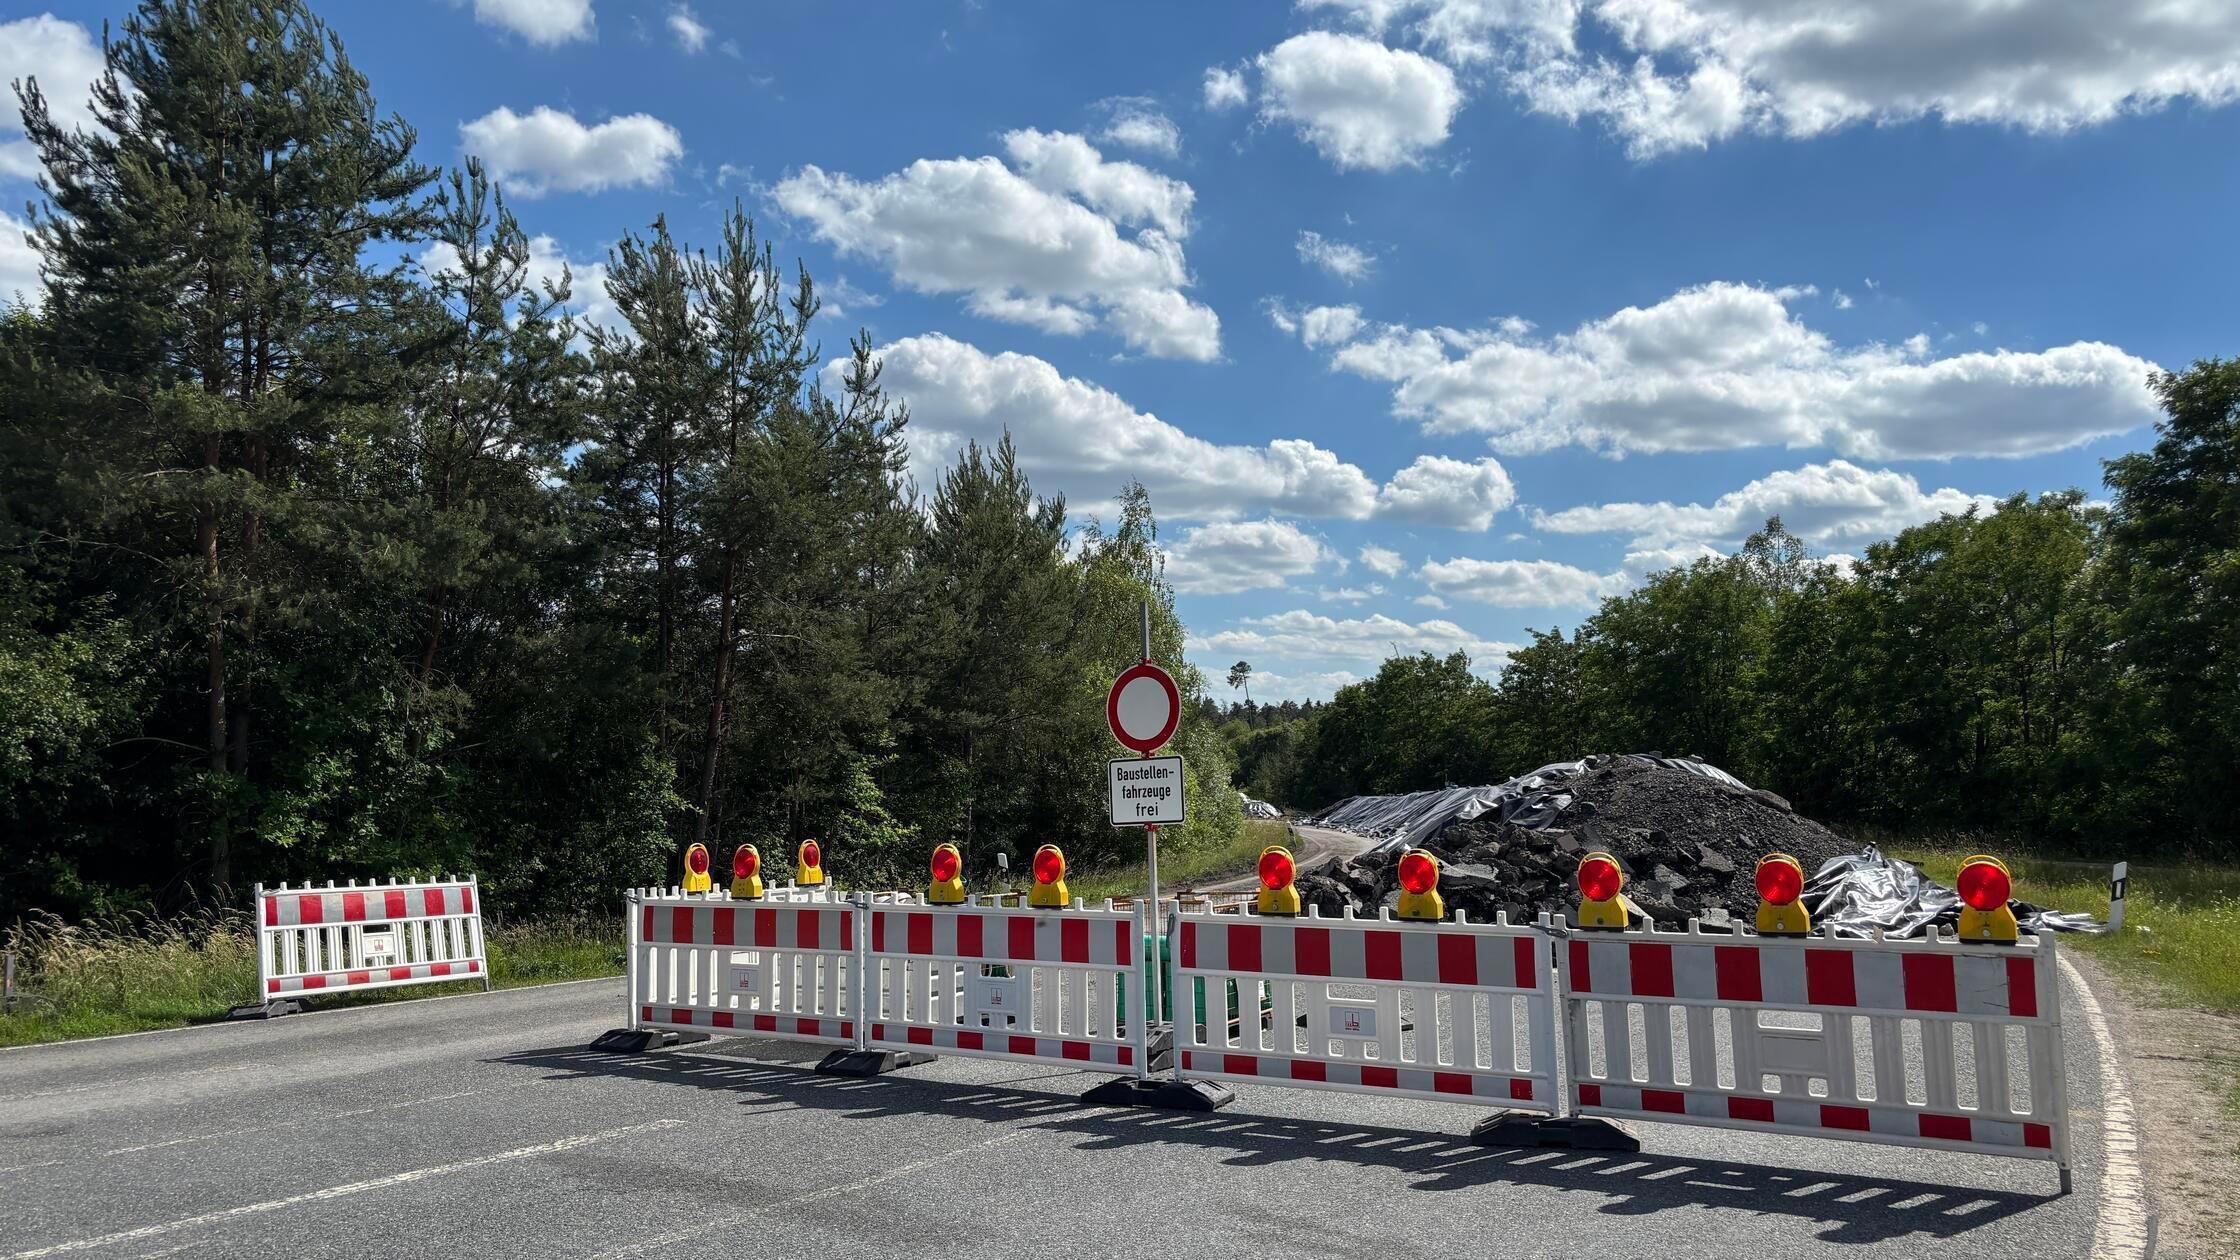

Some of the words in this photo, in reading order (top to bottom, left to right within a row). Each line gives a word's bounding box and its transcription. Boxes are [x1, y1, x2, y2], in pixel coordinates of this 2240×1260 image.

[1117, 765, 1174, 781] Baustellen-
[1122, 785, 1171, 800] fahrzeuge
[1136, 802, 1159, 816] frei
